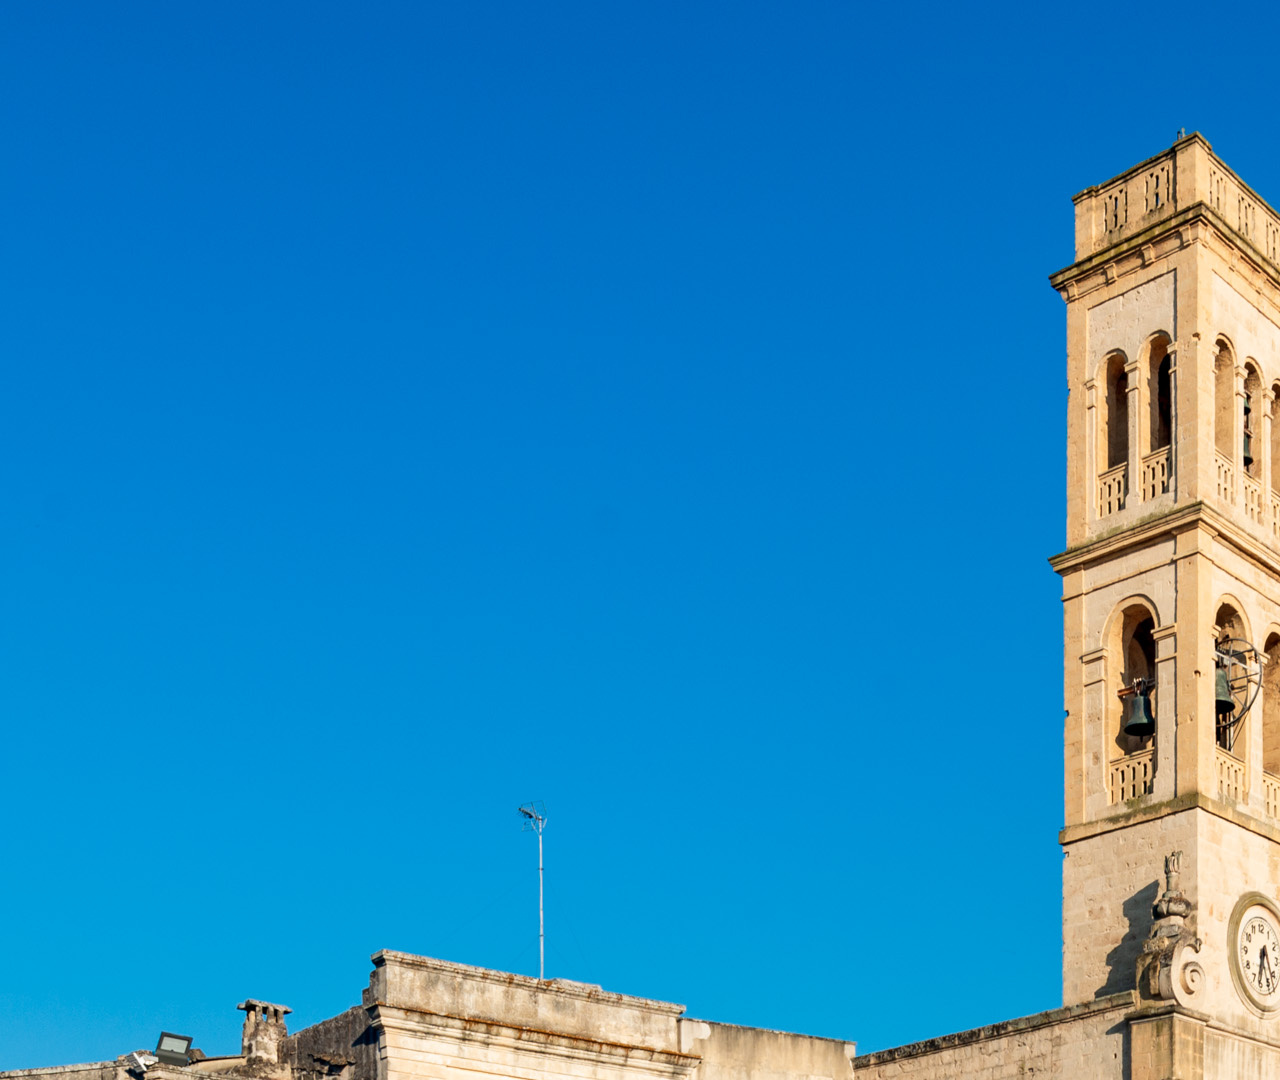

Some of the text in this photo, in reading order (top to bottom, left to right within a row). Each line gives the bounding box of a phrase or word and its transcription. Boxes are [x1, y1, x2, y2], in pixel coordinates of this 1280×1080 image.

[1251, 924, 1256, 934] 11
[1258, 924, 1264, 934] 12
[1246, 932, 1251, 943] 10
[1243, 946, 1248, 955] 9
[1272, 942, 1276, 952] 2
[1246, 960, 1250, 970] 8
[1275, 957, 1278, 966] 3
[1252, 973, 1256, 982] 7
